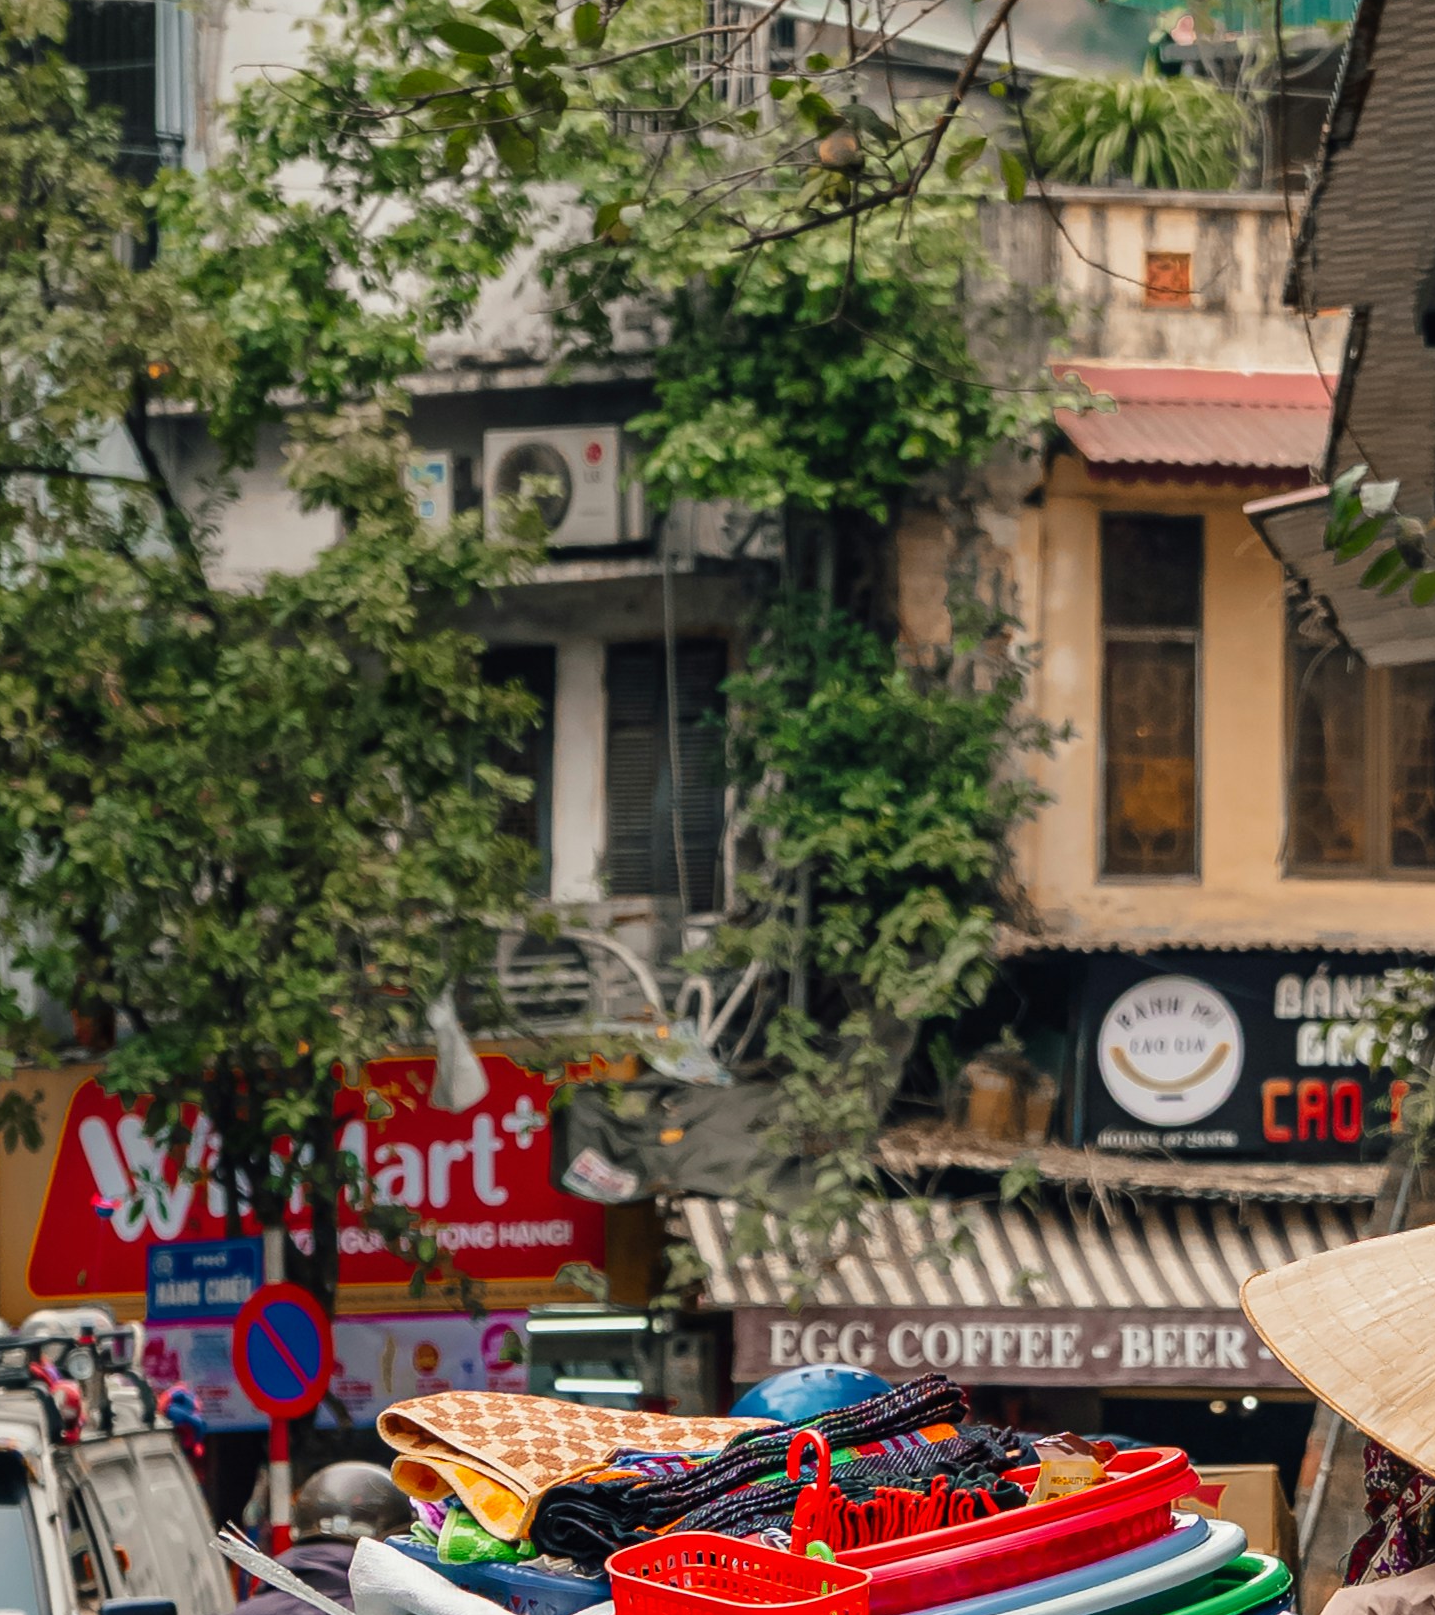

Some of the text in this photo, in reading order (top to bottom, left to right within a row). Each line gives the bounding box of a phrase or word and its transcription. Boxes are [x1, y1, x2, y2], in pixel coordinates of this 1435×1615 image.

[1262, 1078, 1363, 1143] CAO
[769, 1320, 877, 1367] EGG
[886, 1320, 1083, 1369] COFFEE
[1118, 1323, 1249, 1370] BEER
